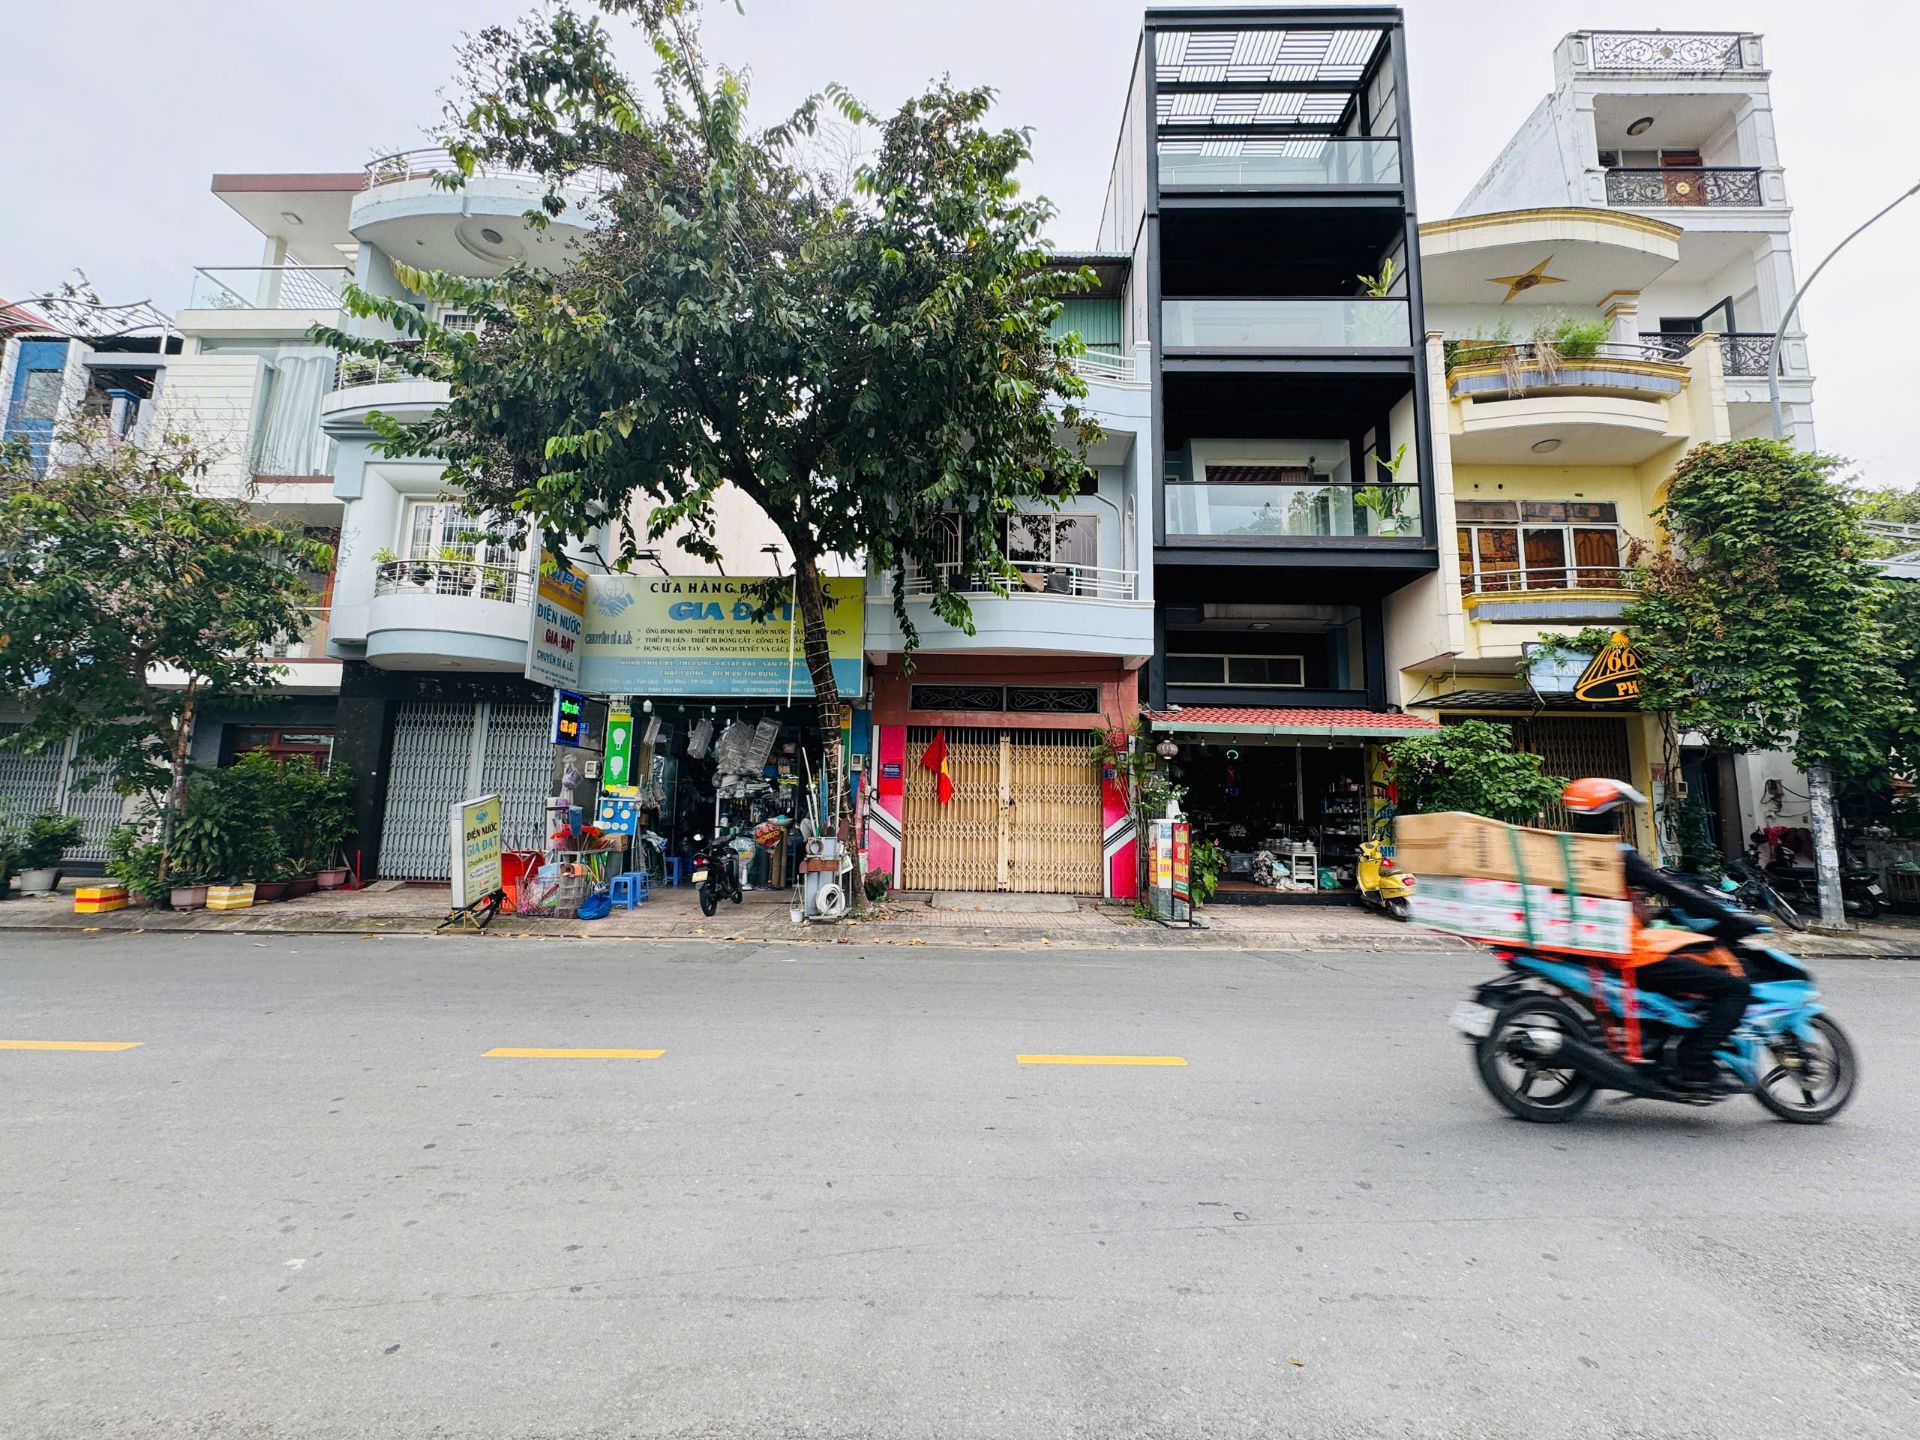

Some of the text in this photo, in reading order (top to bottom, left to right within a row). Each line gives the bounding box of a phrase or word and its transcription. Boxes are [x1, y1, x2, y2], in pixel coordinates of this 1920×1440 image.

[650, 579, 682, 593] CỬA
[688, 580, 734, 594] HÀNG
[537, 603, 581, 635] ĐIỆN NƯỚC
[668, 601, 799, 622] GIA ĐT
[545, 628, 576, 654] GIA ĐẠT
[1607, 648, 1635, 671] 66
[466, 821, 498, 842] ĐIỆN NƯỚC
[466, 834, 499, 857] GIA ĐẠT
